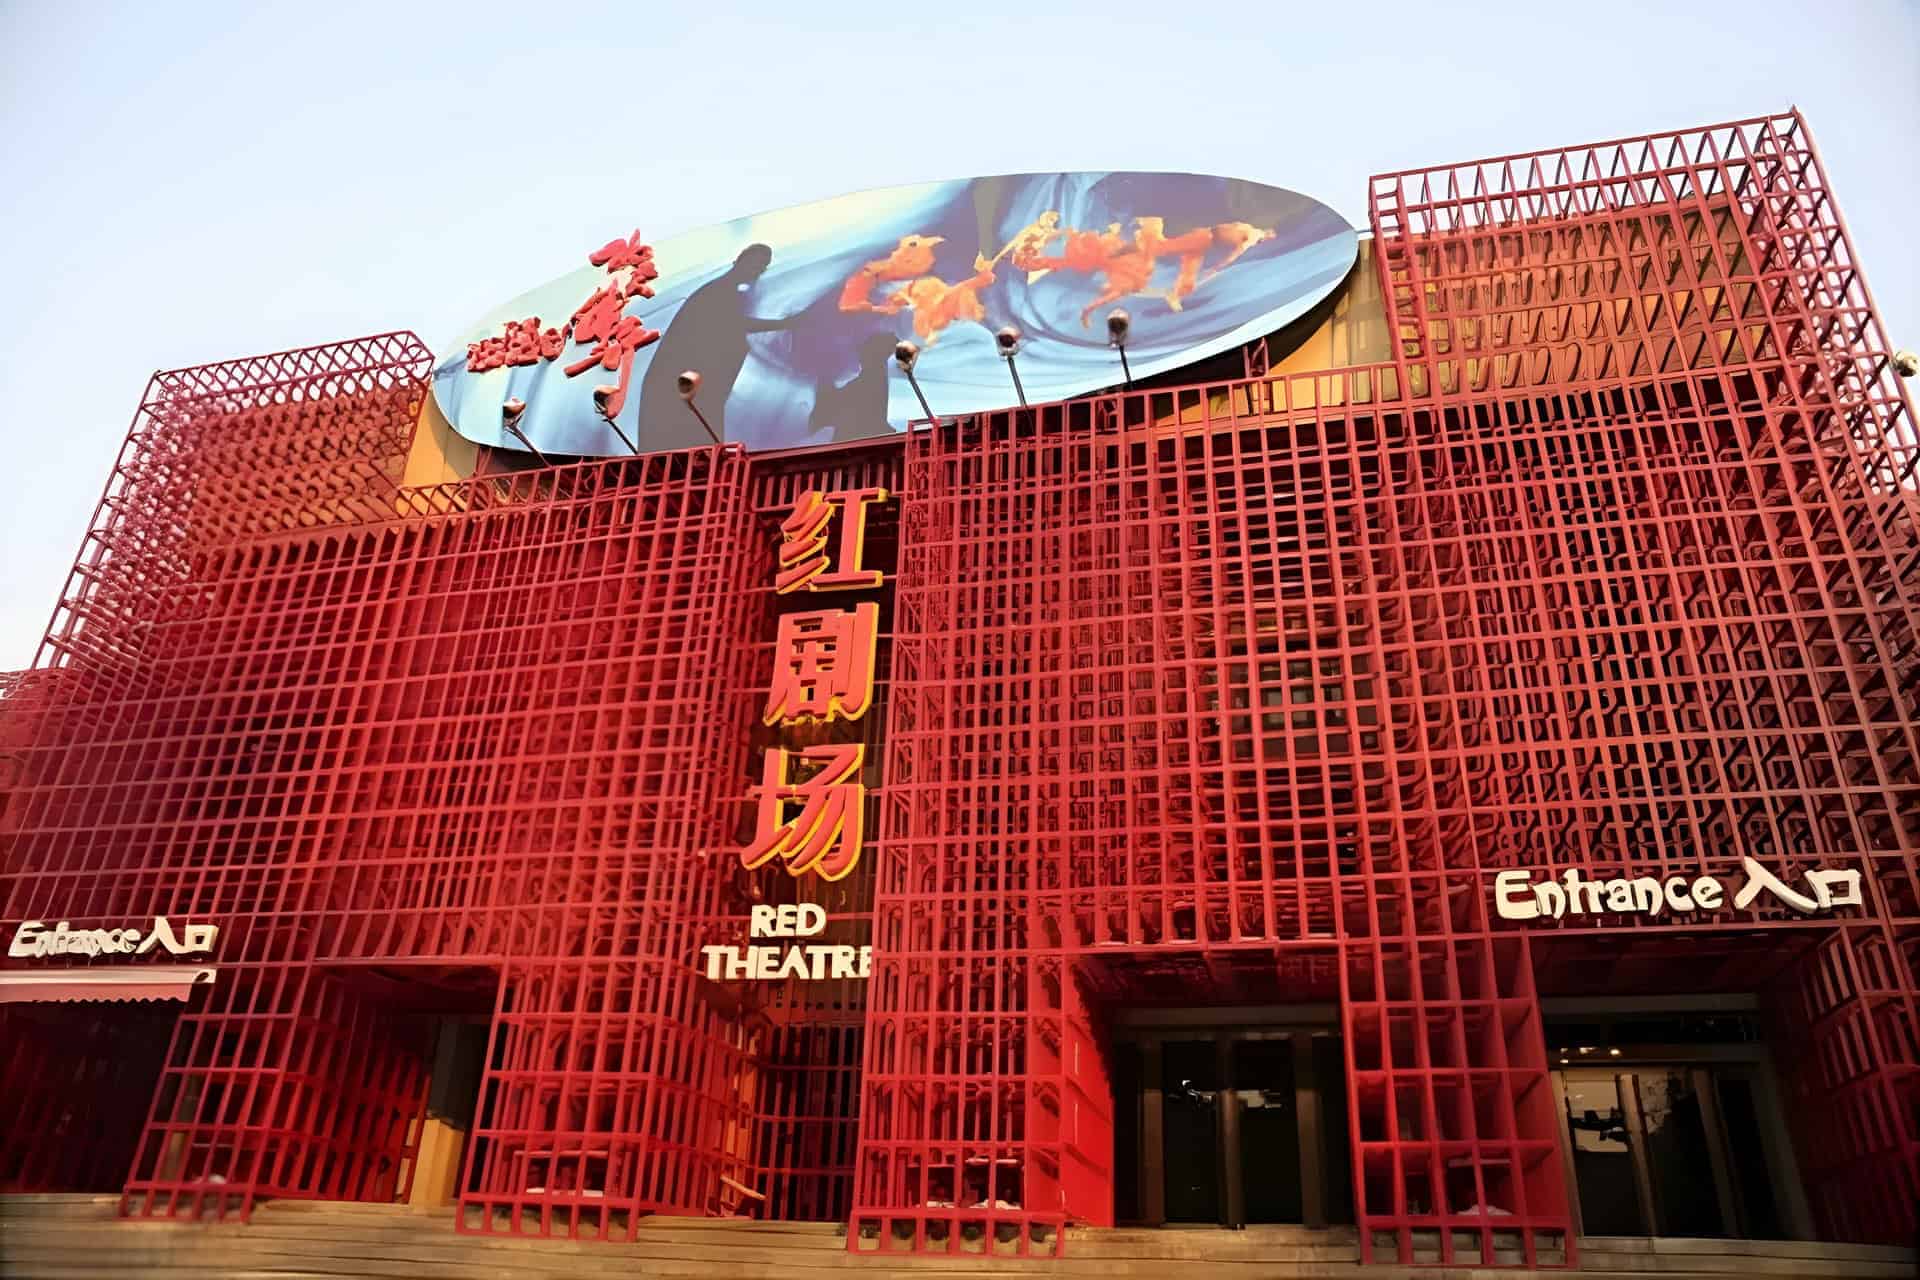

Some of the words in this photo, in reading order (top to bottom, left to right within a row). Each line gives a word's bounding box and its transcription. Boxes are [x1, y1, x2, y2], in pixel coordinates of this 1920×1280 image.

[740, 487, 888, 882] 红剧场
[1495, 867, 1724, 920] Entrance
[1734, 856, 1862, 914] 入口
[8, 920, 141, 958] Entrance
[135, 915, 219, 954] 入口
[750, 903, 827, 938] RED
[700, 944, 872, 980] THEATRE
